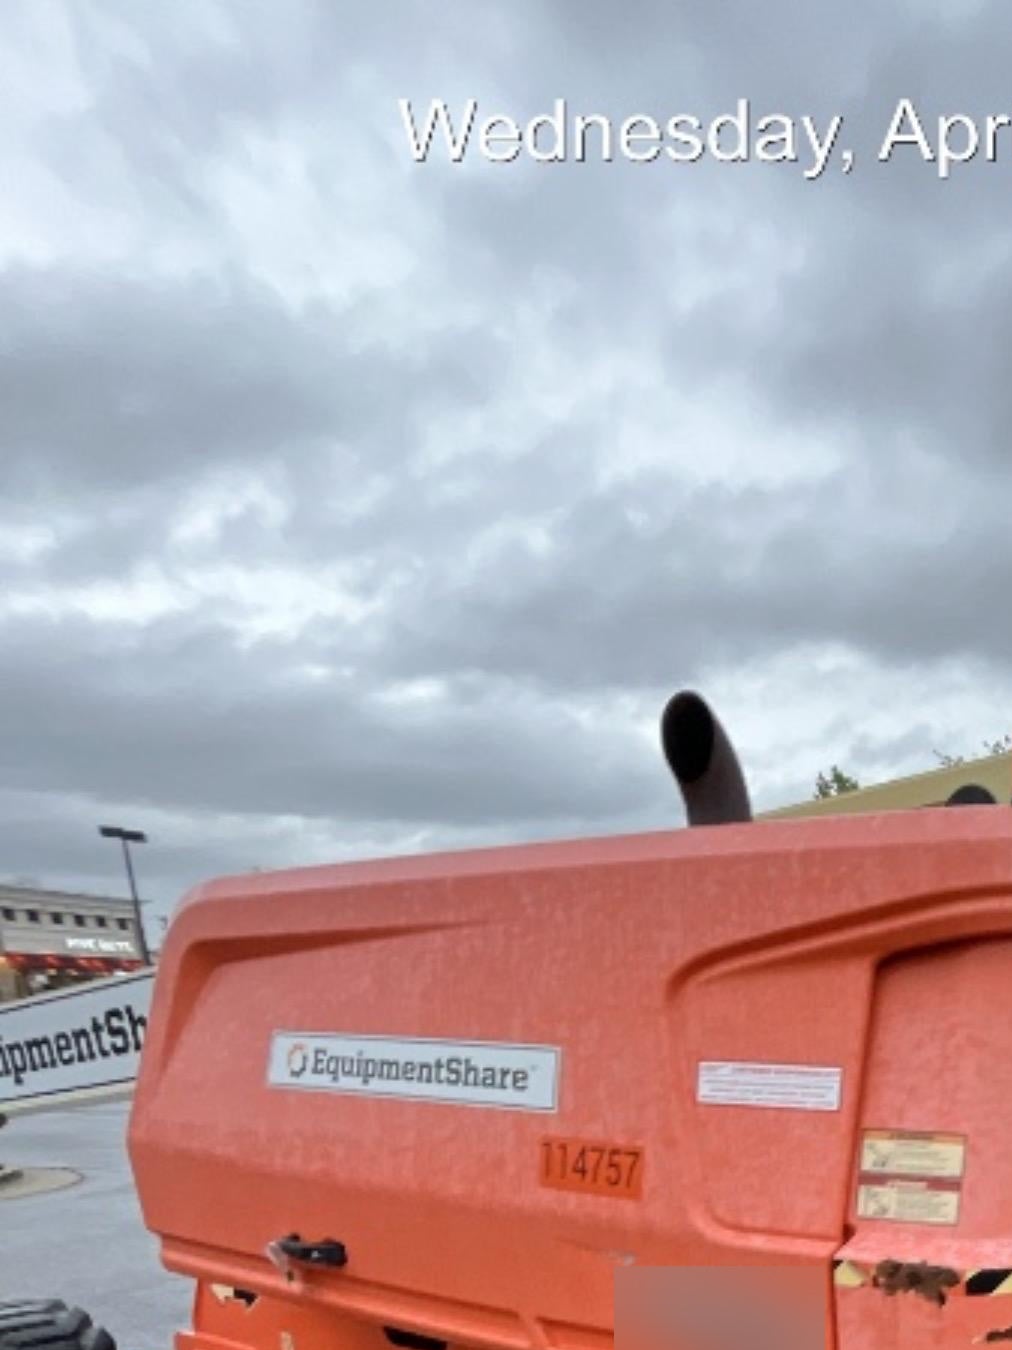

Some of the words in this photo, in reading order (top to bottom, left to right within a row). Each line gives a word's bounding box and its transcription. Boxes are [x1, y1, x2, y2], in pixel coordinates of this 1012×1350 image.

[0, 1004, 147, 1085] ipmentSh
[310, 1047, 530, 1092] EquipmentShare
[541, 1142, 641, 1190] 114757
